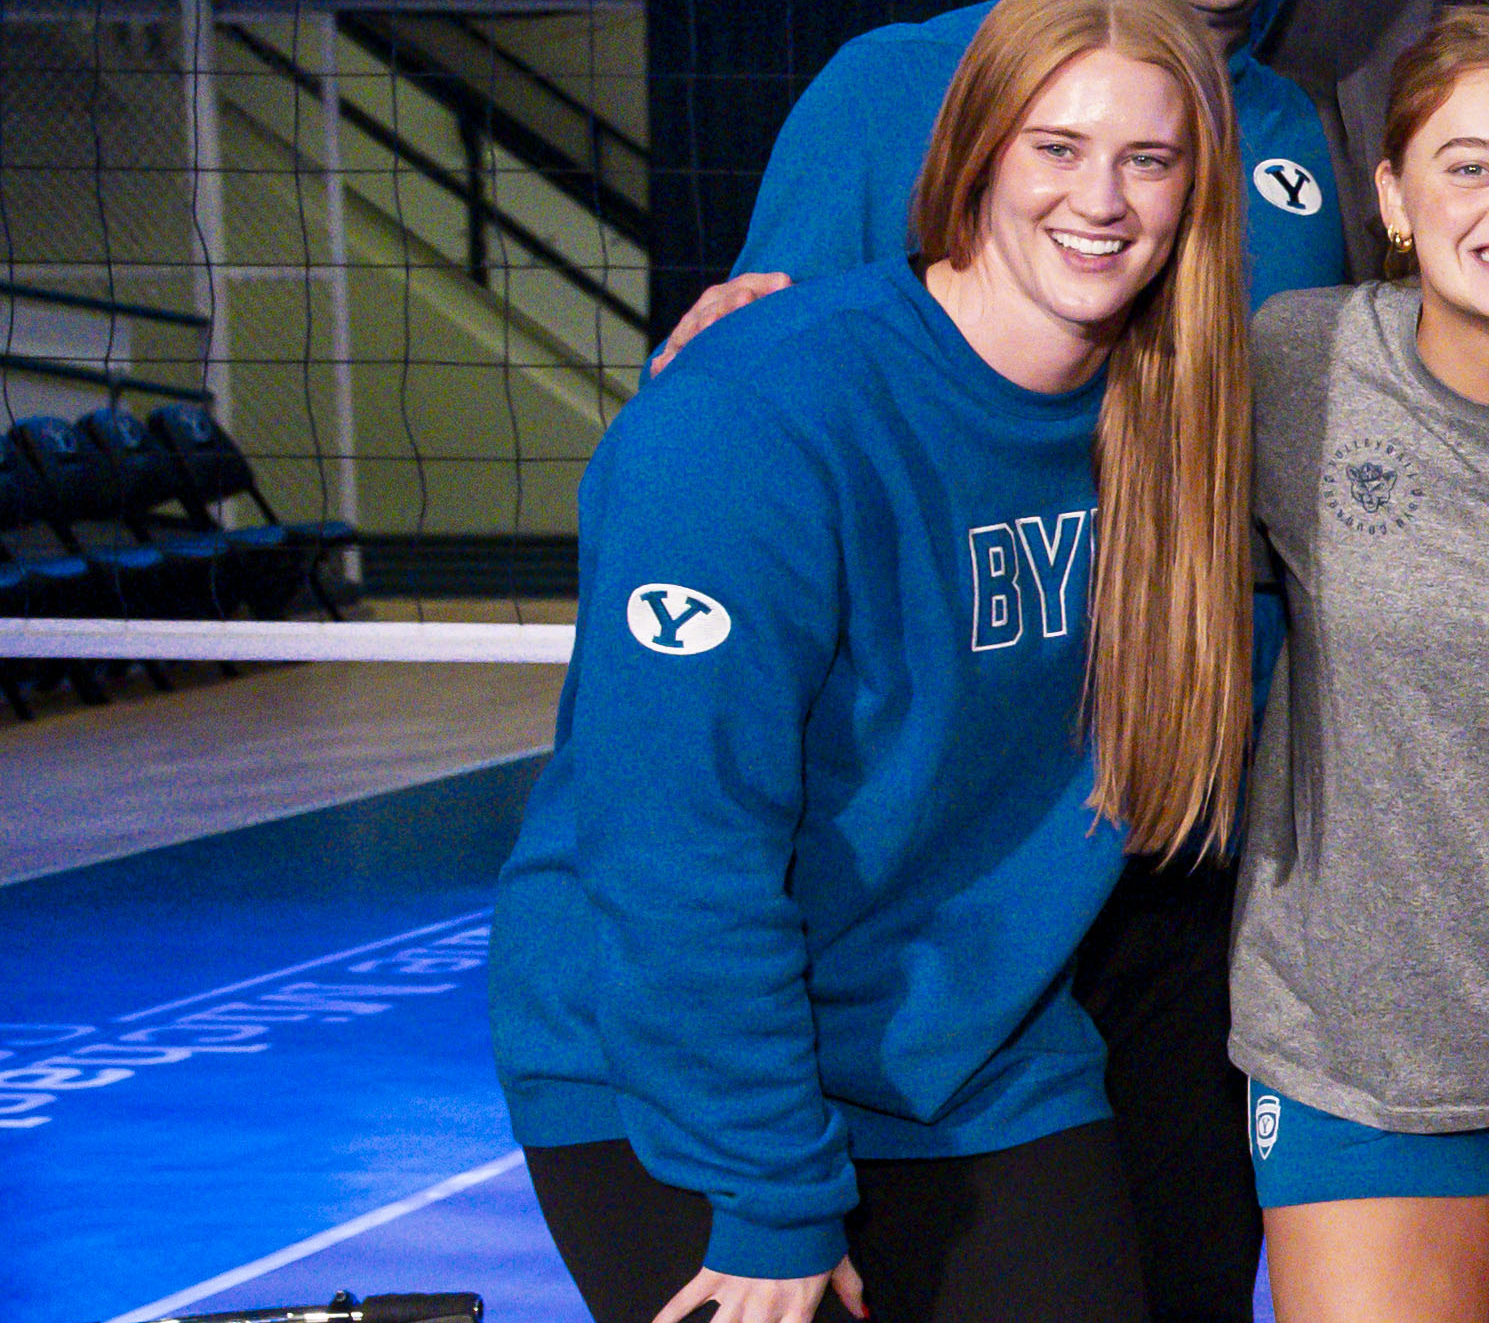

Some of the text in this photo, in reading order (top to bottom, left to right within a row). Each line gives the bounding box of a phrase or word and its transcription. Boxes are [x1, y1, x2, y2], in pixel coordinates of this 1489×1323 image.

[1264, 164, 1311, 210] Y
[968, 507, 1099, 652] BY
[640, 589, 713, 648] Y
